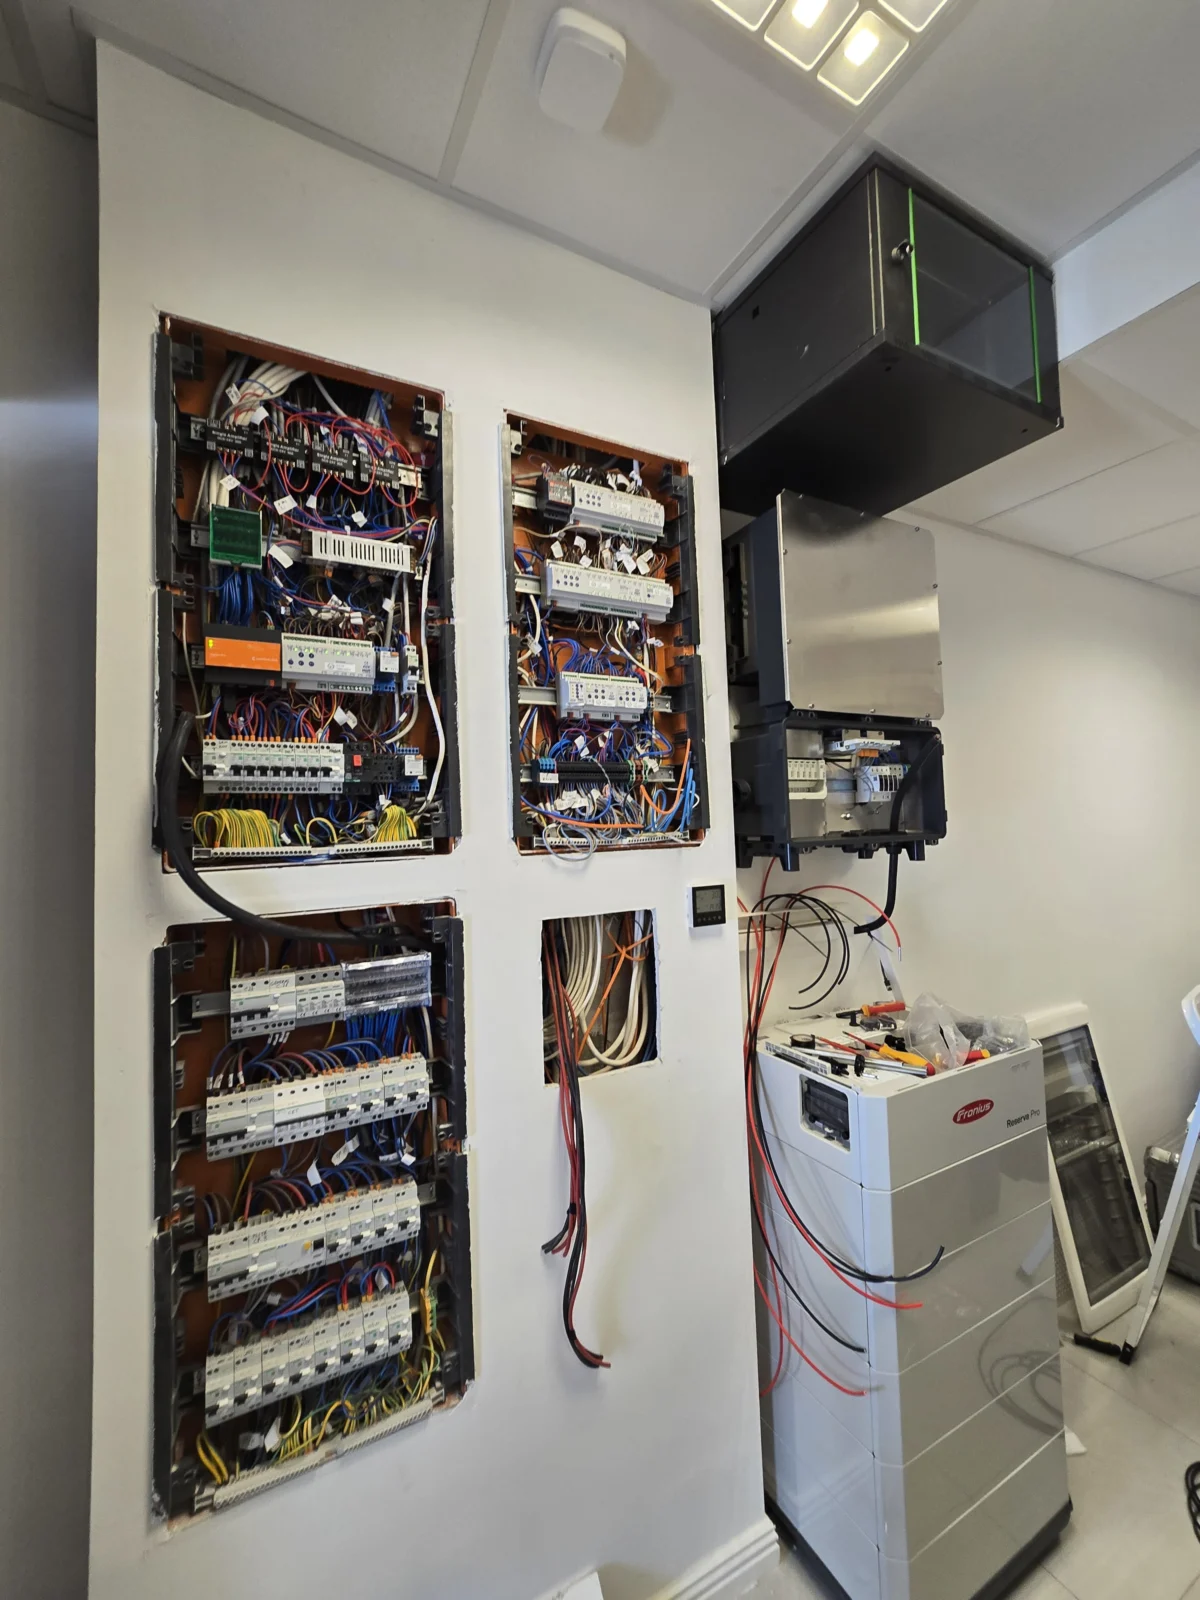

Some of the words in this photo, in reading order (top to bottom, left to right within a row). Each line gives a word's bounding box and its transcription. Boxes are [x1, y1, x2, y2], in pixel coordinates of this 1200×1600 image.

[957, 1102, 991, 1122] Fronius
[1006, 1113, 1030, 1129] Reserve
[1030, 1109, 1040, 1119] Pro
